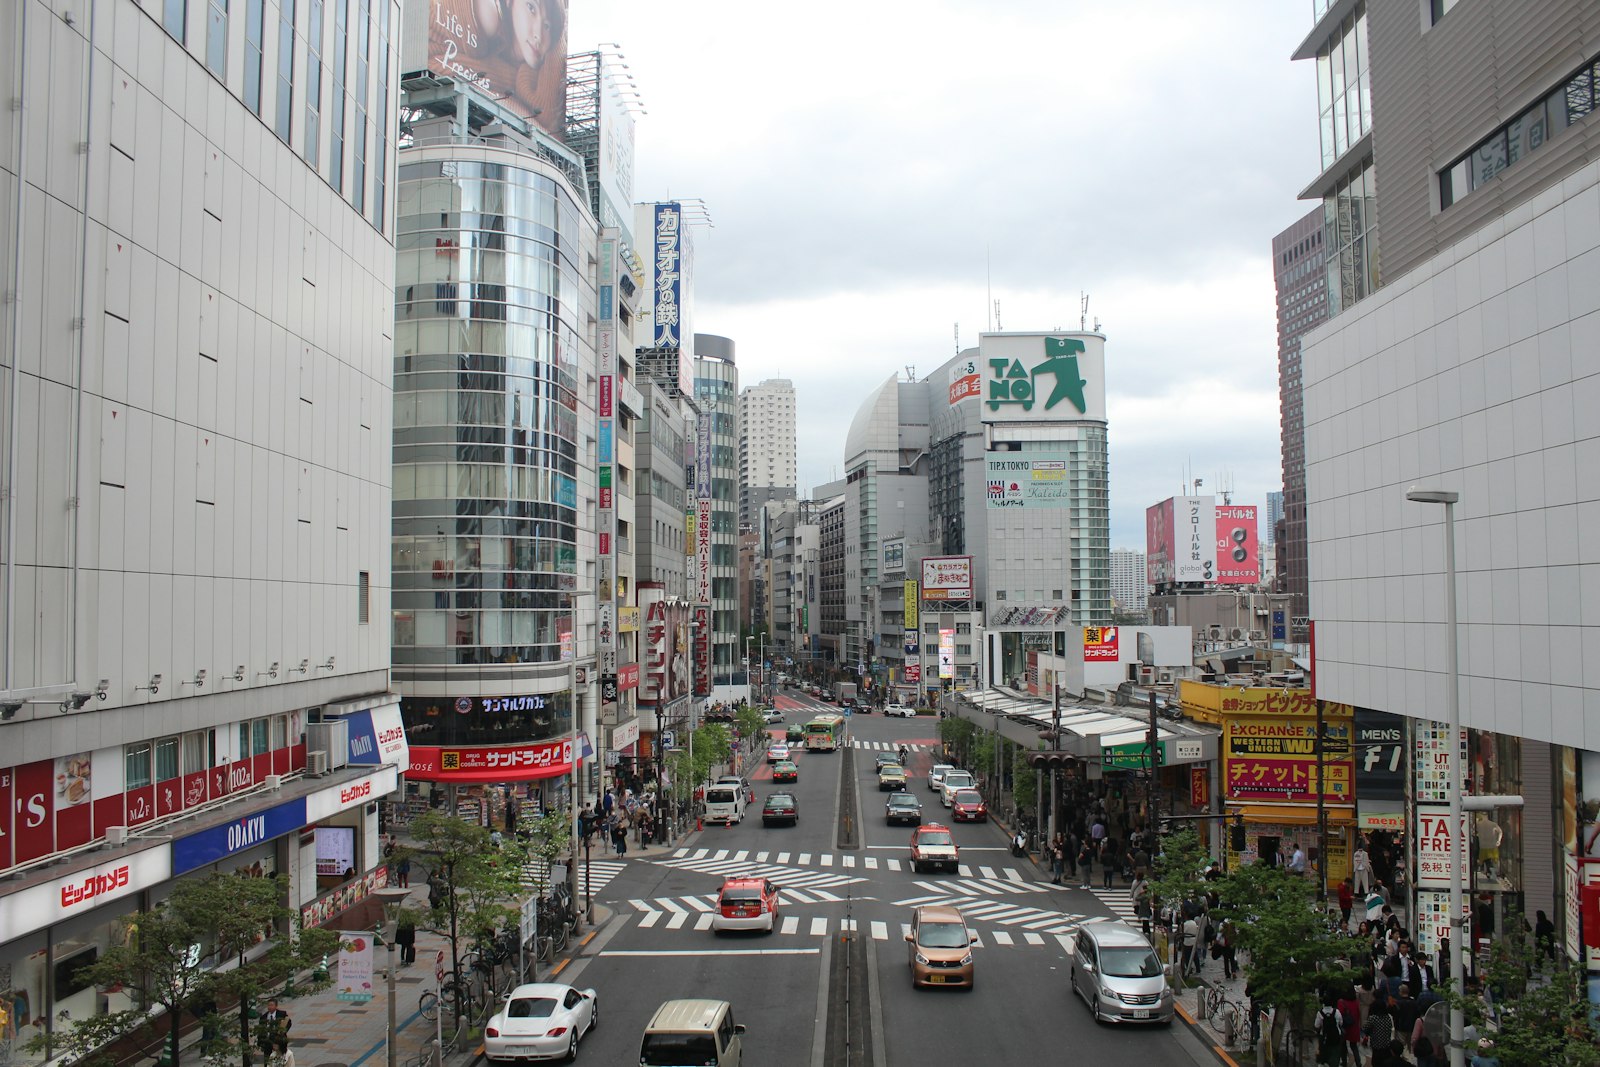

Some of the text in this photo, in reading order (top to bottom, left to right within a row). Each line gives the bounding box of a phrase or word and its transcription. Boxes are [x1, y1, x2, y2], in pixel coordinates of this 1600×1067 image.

[435, 3, 478, 48] Life is
[438, 40, 490, 90] Precious
[656, 208, 680, 347] カラオケの鉄人
[1007, 461, 1029, 471] TOKYO
[1027, 487, 1068, 498] Kaleido
[1191, 507, 1201, 561] グローバル社
[1180, 565, 1203, 576] global
[1087, 629, 1099, 642] 薬
[647, 601, 666, 694] パチンコ
[1084, 649, 1118, 657] サンドラッグ
[482, 697, 544, 713] サンマルクカフェ
[1222, 692, 1352, 714] 金券ショップ ビックチット
[378, 726, 403, 745] ビックカメラ
[1230, 725, 1348, 738] EXCHANGE 外両替
[1362, 728, 1400, 741] MEN'S
[351, 735, 372, 757] ODAKYU
[1233, 738, 1281, 746] WESTERN
[1248, 745, 1281, 753] UNION
[1285, 739, 1313, 753] WU
[443, 753, 459, 769] 薬
[486, 748, 551, 767] サンドラッグ
[1434, 753, 1450, 764] UT
[409, 762, 433, 773] KOSÉ
[1230, 763, 1306, 783] チケット
[340, 780, 370, 805] ビックカメラ
[1368, 815, 1405, 826] men's
[228, 815, 265, 850] ODAKYU
[1421, 862, 1443, 874] 免税
[61, 865, 129, 908] ビックカメラ
[1436, 926, 1452, 938] UT
